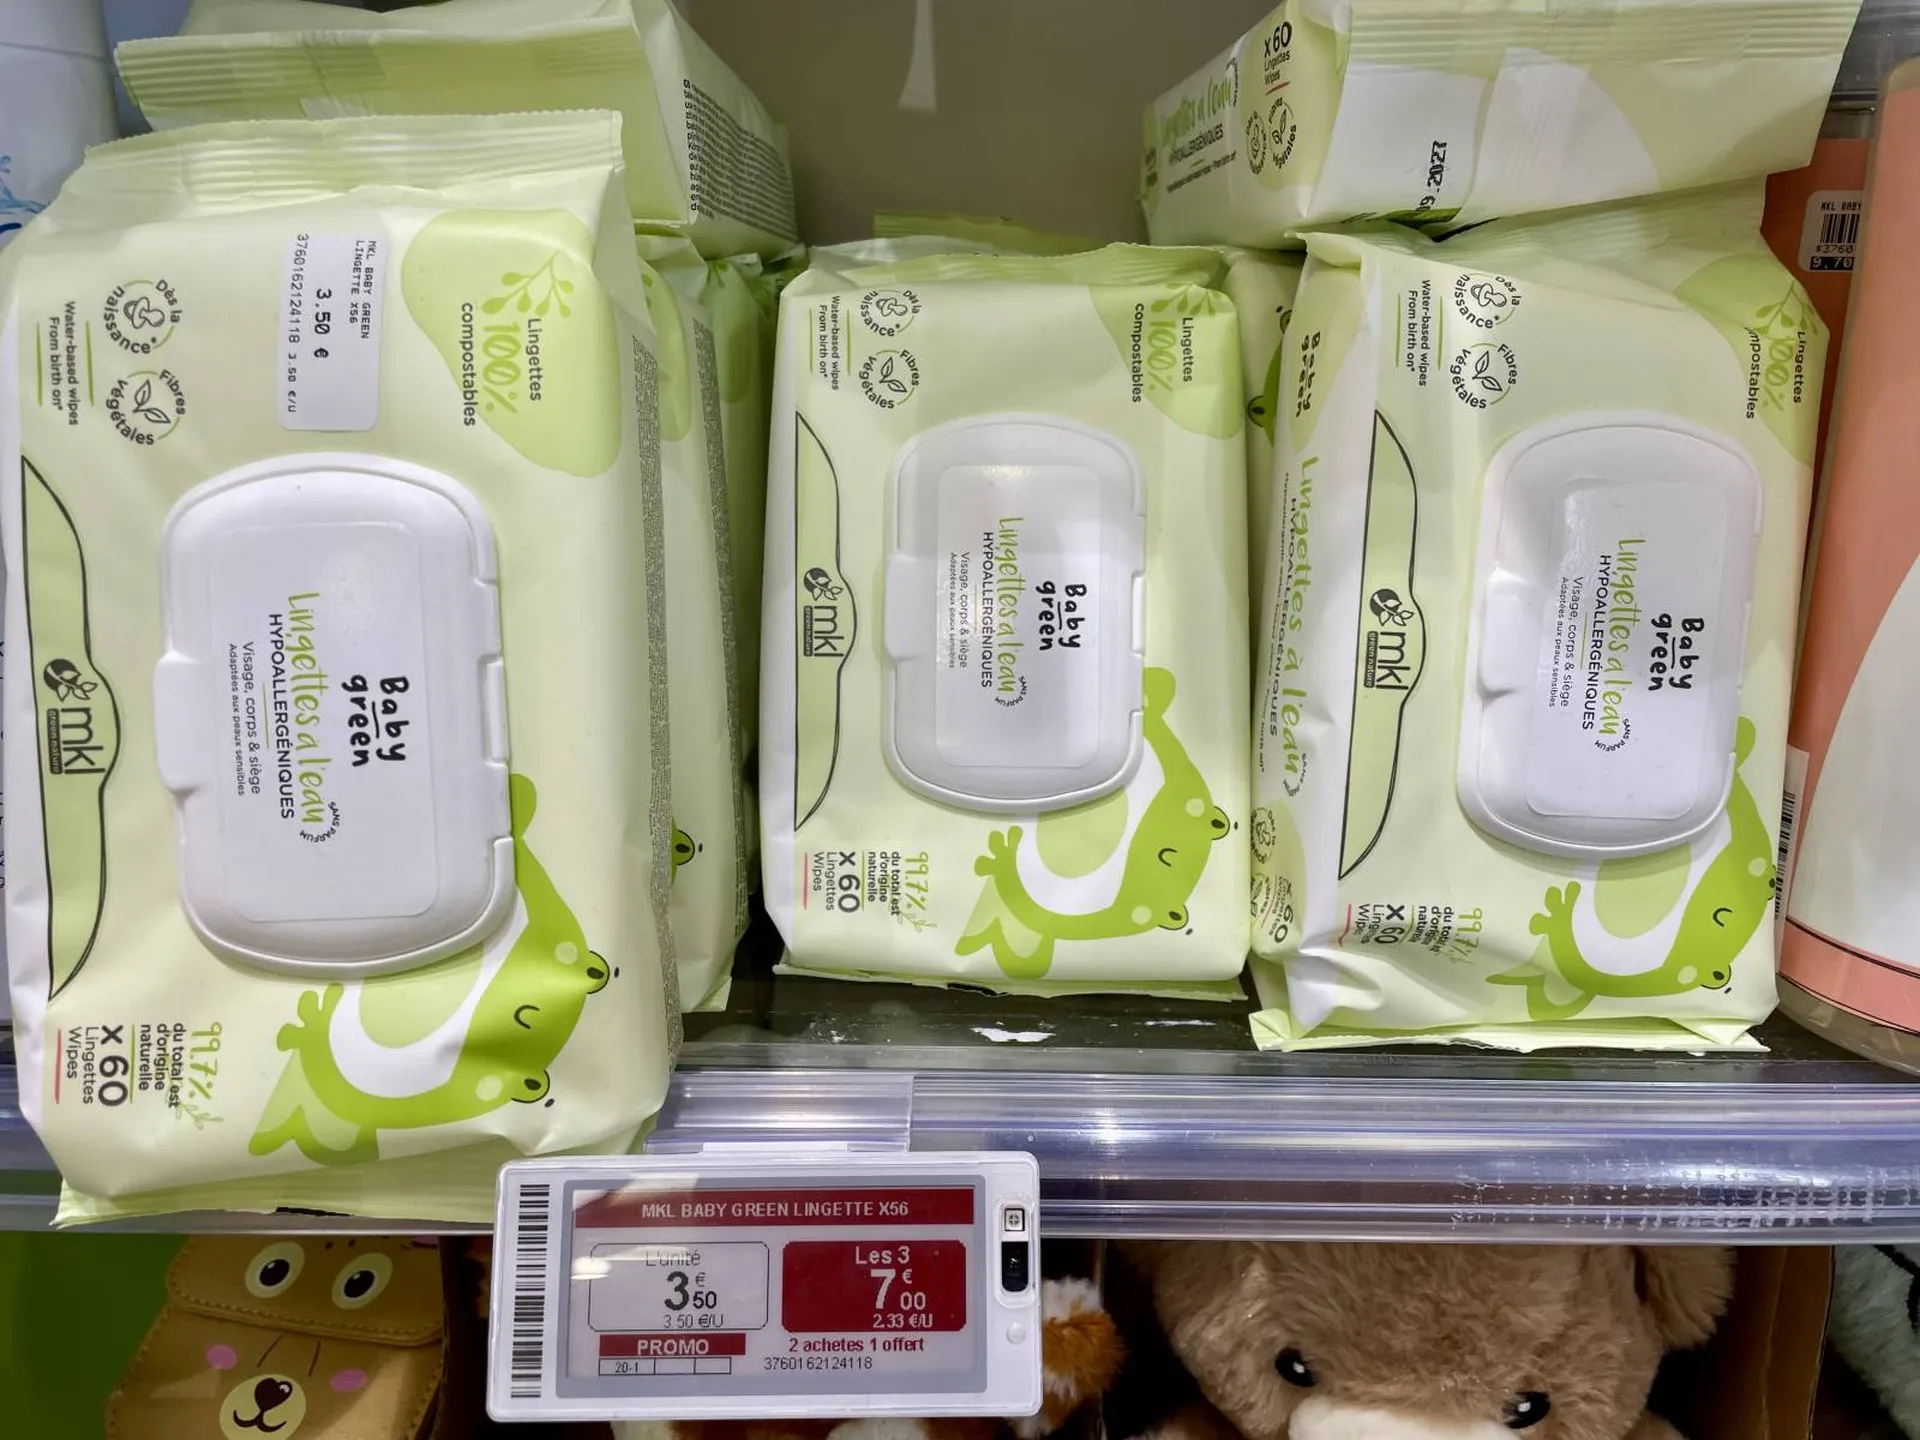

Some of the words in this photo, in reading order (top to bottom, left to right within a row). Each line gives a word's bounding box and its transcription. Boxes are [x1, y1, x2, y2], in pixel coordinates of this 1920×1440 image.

[350, 240, 364, 295] LINGETTE
[366, 240, 376, 260] MKL
[1812, 257, 1852, 268] 9.70
[288, 233, 309, 343] 3760162124118
[363, 267, 373, 295] BABY
[1511, 295, 1522, 306] la
[155, 279, 179, 306] Dès
[170, 310, 183, 323] la
[314, 288, 332, 335] 3.50
[350, 302, 358, 324] X56
[361, 302, 371, 339] GREEN
[819, 305, 827, 331] From
[1408, 290, 1418, 319] From
[1421, 279, 1431, 350] Water-based
[49, 316, 60, 350] From
[64, 301, 79, 385] Water-based
[313, 347, 329, 358] €
[819, 335, 828, 359] birth
[1181, 317, 1194, 382] Lingettes
[1408, 322, 1418, 349] birth
[50, 353, 61, 386] birth
[287, 353, 297, 382] 3.50
[458, 302, 478, 426] compostables
[482, 322, 521, 413] 100%
[526, 318, 543, 401] Lingettes
[900, 350, 920, 386] Fibres
[1131, 303, 1145, 403] compostables
[1147, 321, 1176, 392] 100%
[1419, 353, 1430, 386] wipes
[1497, 344, 1518, 385] Fibres
[1793, 331, 1807, 403] Lingettes
[159, 369, 186, 415] Fibres
[831, 361, 840, 390] wipes
[859, 356, 895, 409] végétales
[1450, 348, 1487, 409] végétales
[67, 388, 78, 425] wipes
[106, 379, 155, 446] végétales
[1288, 455, 1319, 634] Lingettes
[959, 552, 970, 592] Visage,
[995, 517, 1026, 619] Lingettes
[959, 593, 968, 626] corps
[981, 531, 994, 688] HYPOALLERGÉNIQUES
[1569, 576, 1584, 620] Visage,
[1608, 538, 1646, 652] Lingettes
[814, 606, 844, 657] mkl
[960, 627, 970, 635] &
[1035, 581, 1056, 650] green
[1058, 584, 1087, 648] Baby
[285, 592, 329, 727] Lingettes
[958, 639, 968, 668] siège
[1376, 632, 1411, 690] mkl
[1553, 640, 1562, 665] peaux
[1565, 624, 1577, 659] corps
[1582, 555, 1612, 731] HYPOALLERGÉNIQUES
[1648, 613, 1672, 691] green
[1669, 617, 1705, 690] Baby
[229, 643, 238, 690] Adaptées
[242, 641, 256, 694] Visage,
[1565, 662, 1575, 671] &
[232, 693, 240, 712] aux
[1549, 667, 1560, 708] sensibles
[1561, 674, 1573, 707] siège
[233, 715, 242, 746] peaux
[245, 697, 257, 737] corps
[269, 613, 295, 819] HYPOALLERGÉNIQUES
[341, 674, 371, 767] green
[376, 676, 410, 761] Baby
[61, 707, 106, 774] mkl
[248, 740, 259, 752] &
[235, 748, 245, 796] sensibles
[249, 756, 261, 794] siège
[812, 852, 824, 891] Wipes
[868, 852, 878, 902] naturelle
[878, 852, 889, 902] d'origine
[891, 852, 901, 866] du
[824, 852, 837, 911] Lingettes
[838, 874, 860, 913] 60
[891, 868, 901, 896] total
[891, 899, 901, 916] est
[1374, 927, 1405, 944] 60
[173, 1023, 186, 1041] du
[65, 1027, 82, 1079] Wipes
[82, 1027, 99, 1104] Lingettes
[139, 1024, 152, 1091] naturelle
[154, 1023, 170, 1091] d'origine
[171, 1043, 184, 1081] total
[98, 1055, 129, 1107] 60
[168, 1084, 182, 1108] est
[642, 1203, 677, 1219] MKL
[681, 1203, 725, 1219] BABY
[731, 1202, 789, 1218] GREEN
[793, 1201, 874, 1217] LINGETTE
[879, 1201, 909, 1216] X56
[646, 1249, 701, 1267] L'unité
[855, 1246, 892, 1265] Les
[898, 1245, 910, 1264] 3
[664, 1271, 689, 1311] 3
[695, 1272, 706, 1287] €
[870, 1268, 896, 1310] 7
[902, 1268, 913, 1284] €
[692, 1291, 718, 1309] 50
[900, 1291, 926, 1311] 00
[663, 1314, 693, 1328] 3.50
[699, 1314, 723, 1327] €/U
[873, 1314, 904, 1329] 2.33
[908, 1313, 933, 1329] €/U
[637, 1339, 709, 1355] PROMO
[763, 1357, 873, 1371] 3760162124118
[789, 1338, 799, 1352] 2
[802, 1337, 864, 1352] achetes
[870, 1338, 877, 1351] 1
[882, 1337, 925, 1351] offert
[615, 1361, 639, 1373] 20-1
